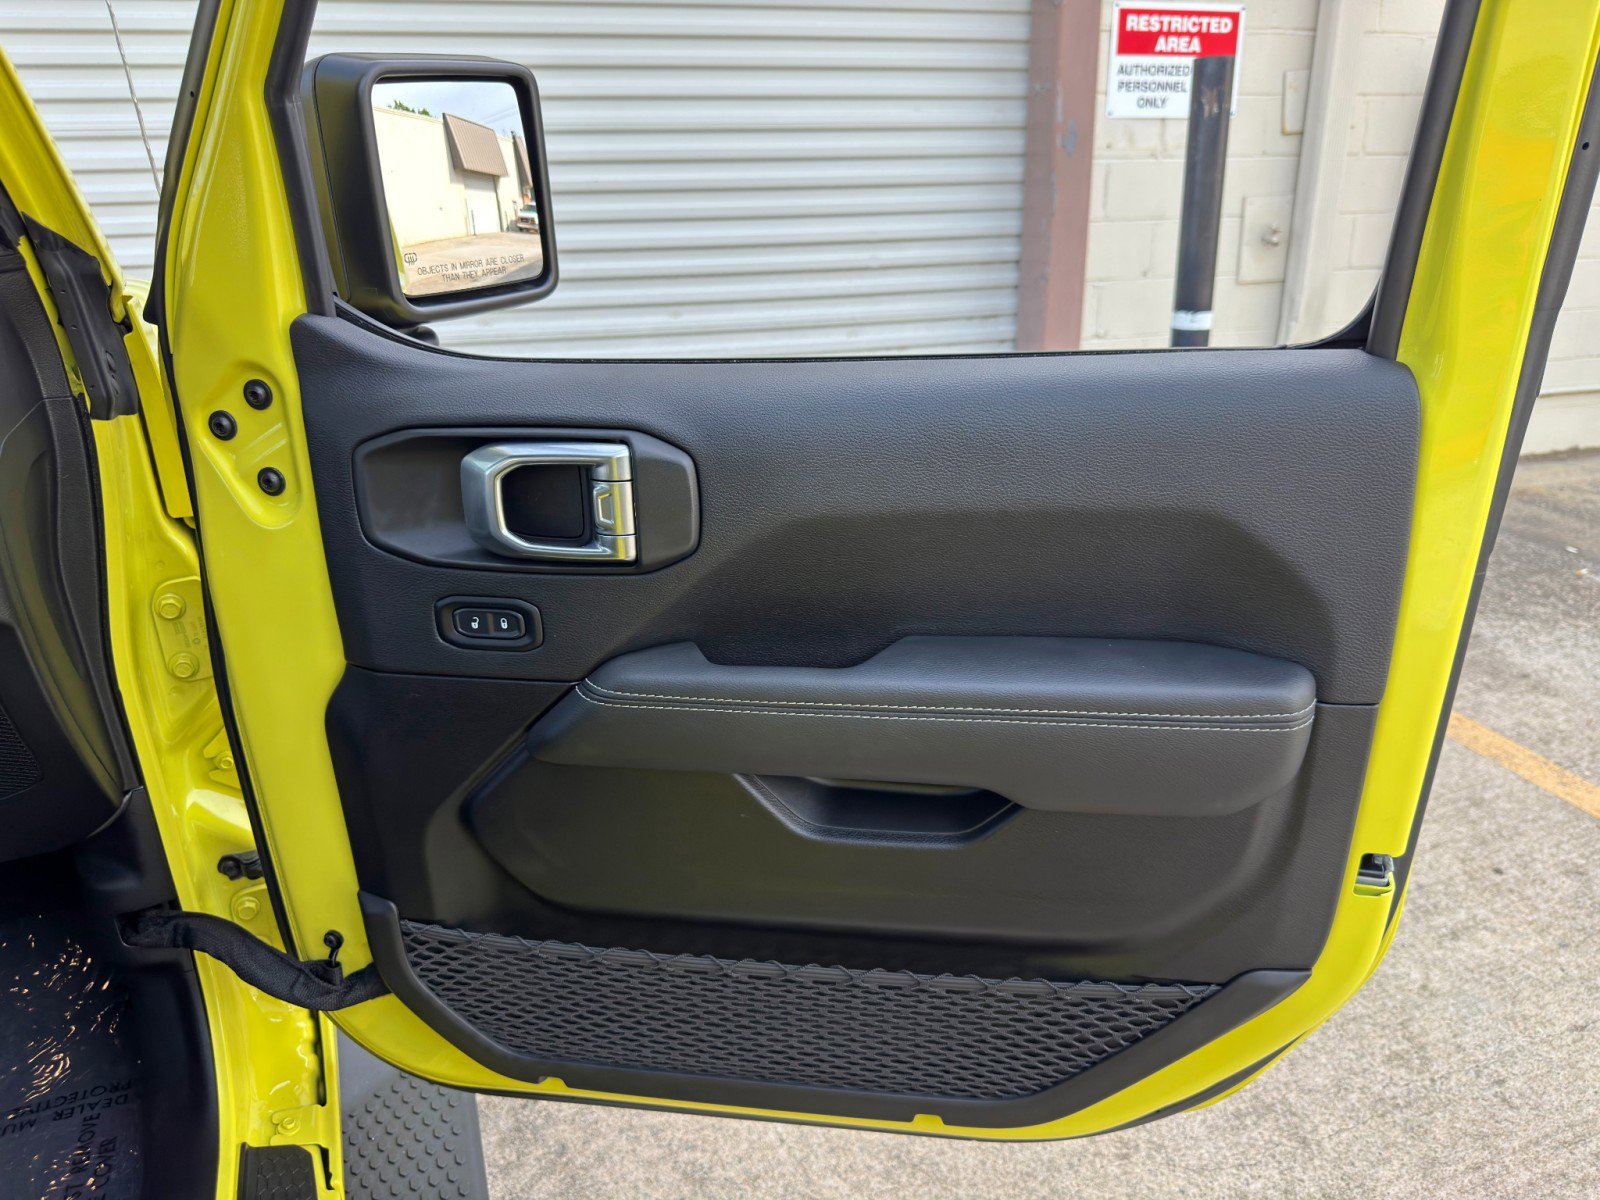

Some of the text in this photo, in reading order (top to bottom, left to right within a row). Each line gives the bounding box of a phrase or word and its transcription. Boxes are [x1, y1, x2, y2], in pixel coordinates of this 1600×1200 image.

[1125, 14, 1233, 33] RESTRICTED
[1154, 35, 1202, 53] AREA
[1116, 64, 1190, 77] AUTHORIZED
[1117, 80, 1188, 93] PERSONNEL
[1136, 96, 1168, 109] ONLY
[417, 254, 525, 276] OBJECTS IN MIRROR ARE CLOSER
[441, 266, 507, 283] THAN THEY APPEAR
[0, 1093, 129, 1137] DEALER MU
